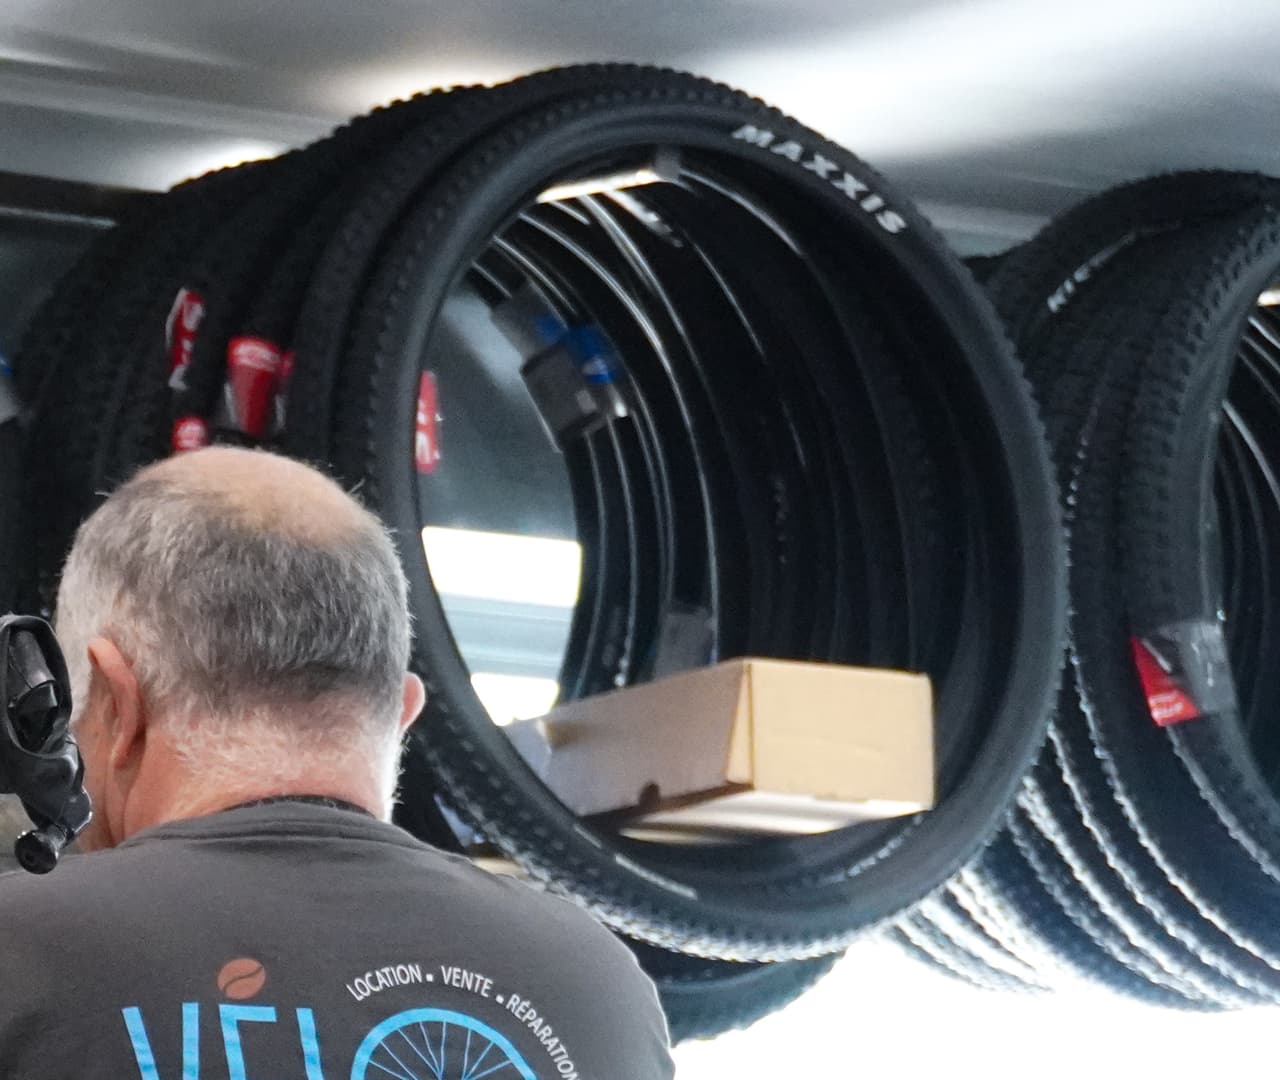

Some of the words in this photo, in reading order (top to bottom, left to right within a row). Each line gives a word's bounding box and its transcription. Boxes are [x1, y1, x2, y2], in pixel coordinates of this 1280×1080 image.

[731, 124, 907, 234] MAXXIS
[346, 964, 423, 1001] LOCATION
[440, 965, 493, 998] VENTE
